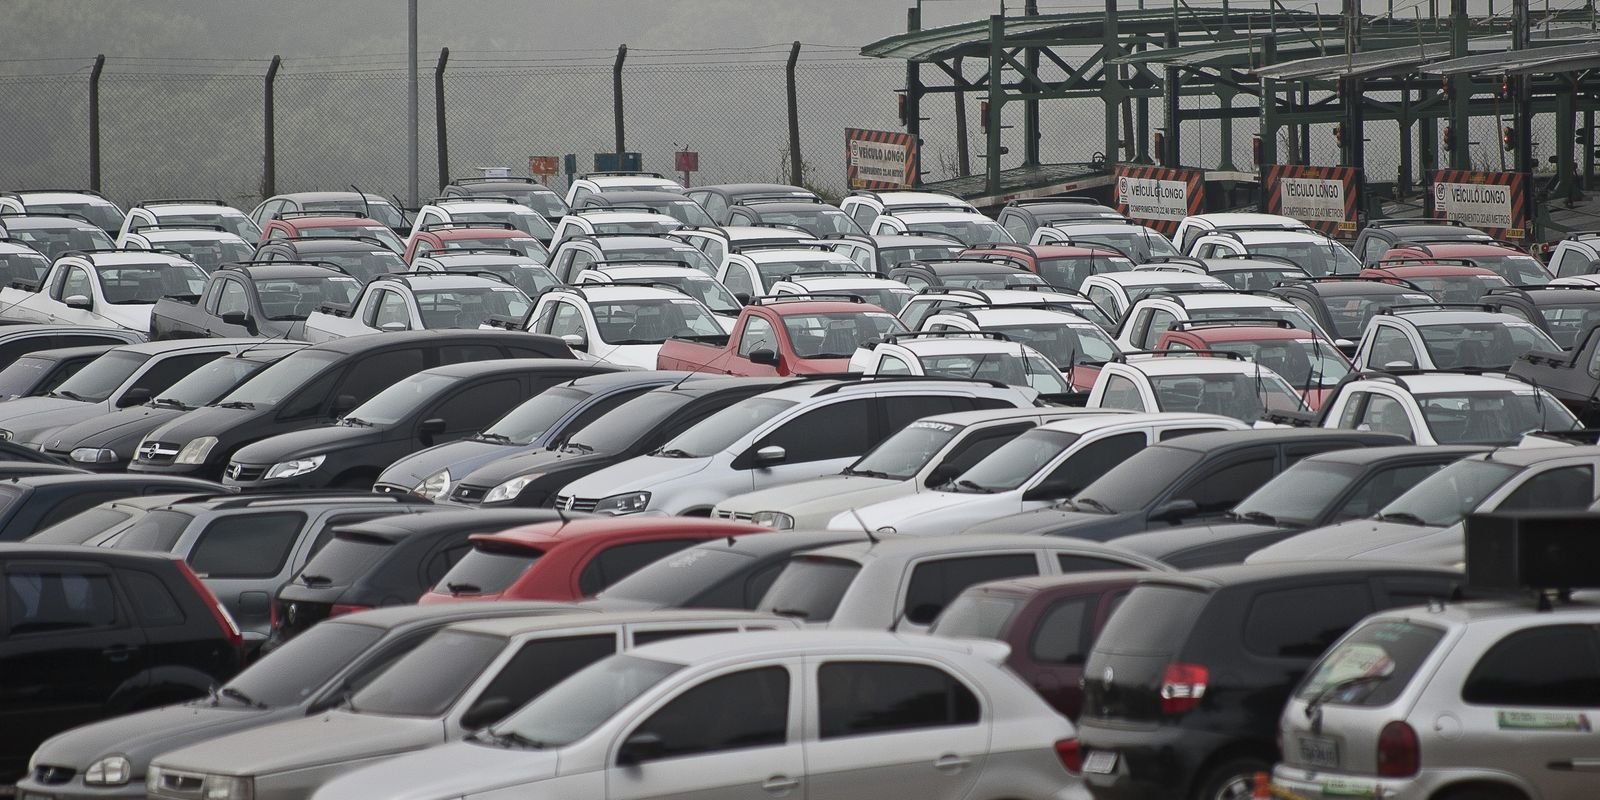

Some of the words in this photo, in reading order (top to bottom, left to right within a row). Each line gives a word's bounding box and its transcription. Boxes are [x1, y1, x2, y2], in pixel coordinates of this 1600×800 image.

[884, 150, 904, 162] LONGO
[1131, 184, 1159, 197] VEÍCULO
[1161, 188, 1184, 200] LONGO
[1286, 182, 1314, 198] VEÍCULO
[1316, 185, 1338, 198] LONGO
[1452, 186, 1480, 202] VEÍCULO
[1481, 190, 1506, 204] LONGO
